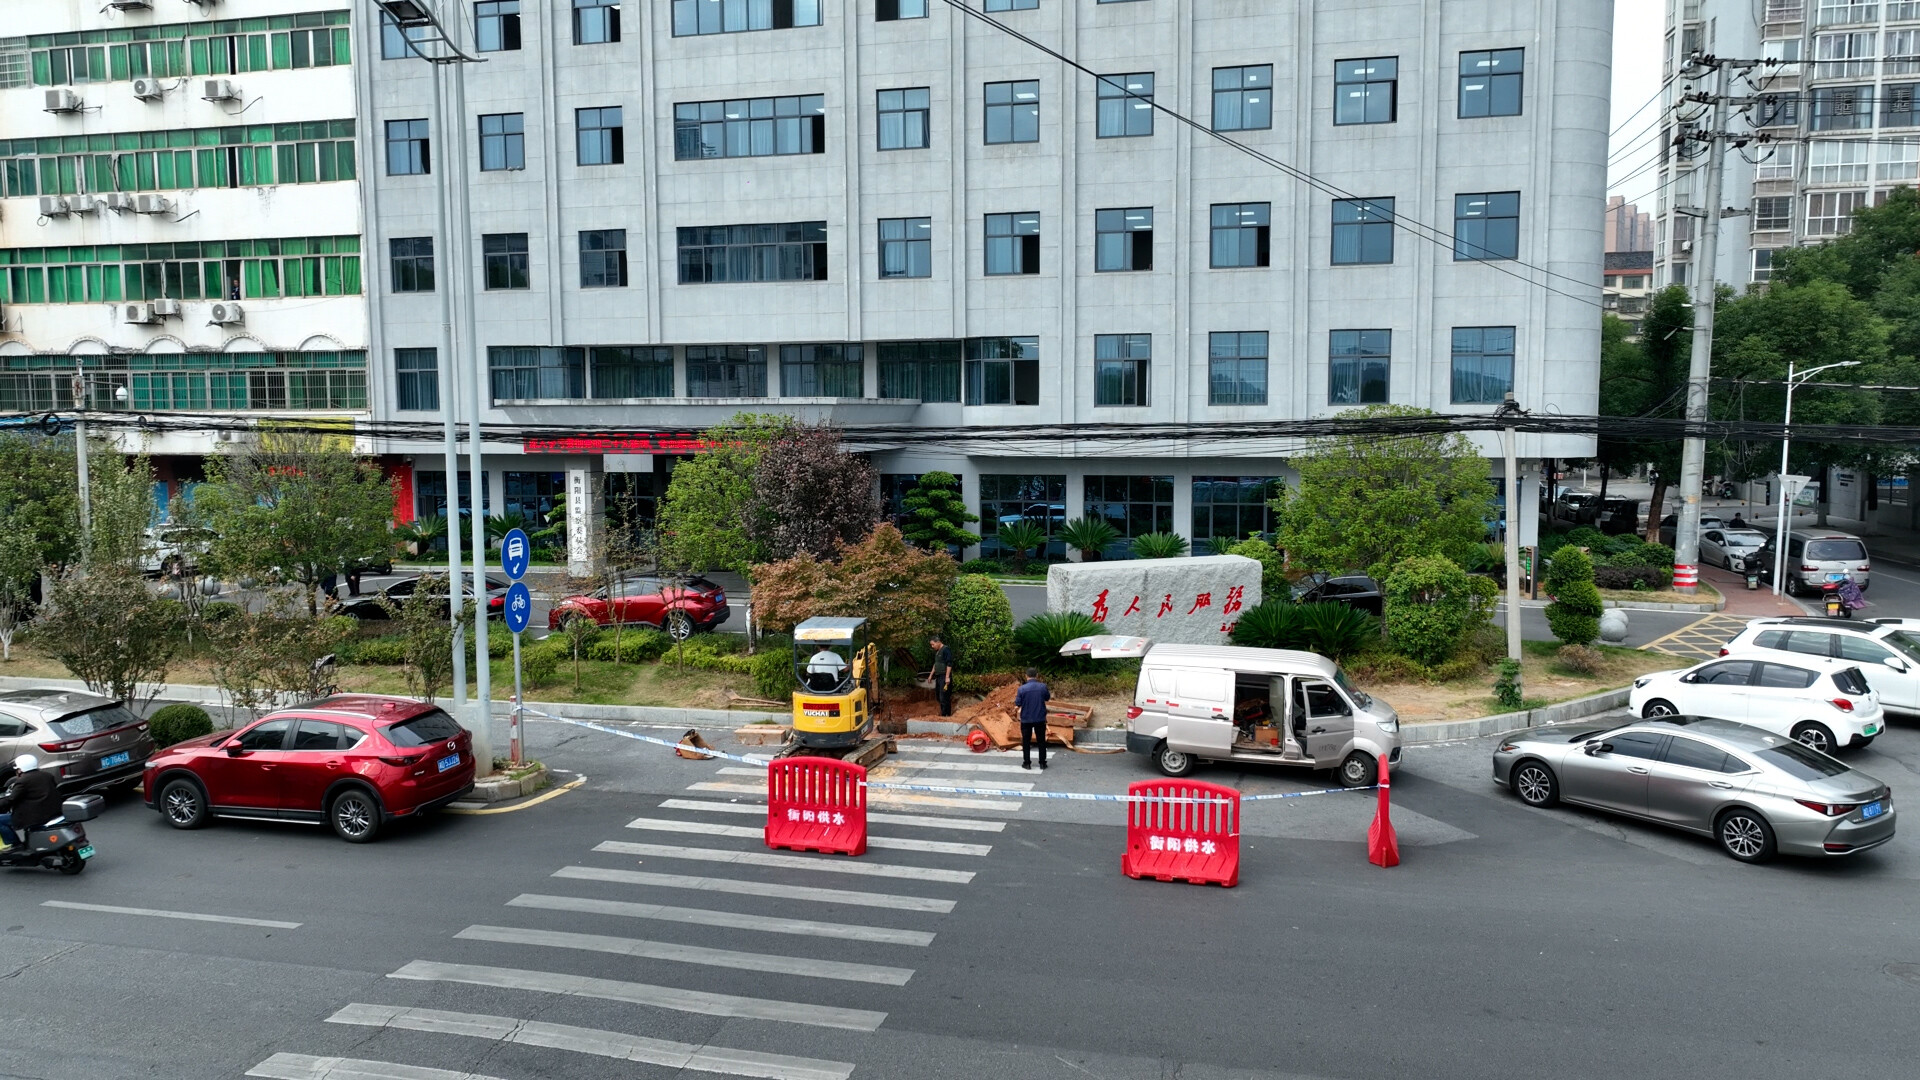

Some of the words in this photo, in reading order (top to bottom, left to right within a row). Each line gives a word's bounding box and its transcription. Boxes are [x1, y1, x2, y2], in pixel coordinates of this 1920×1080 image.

[787, 808, 846, 826] 衡阳供水
[1149, 835, 1217, 855] 衡阳供水
